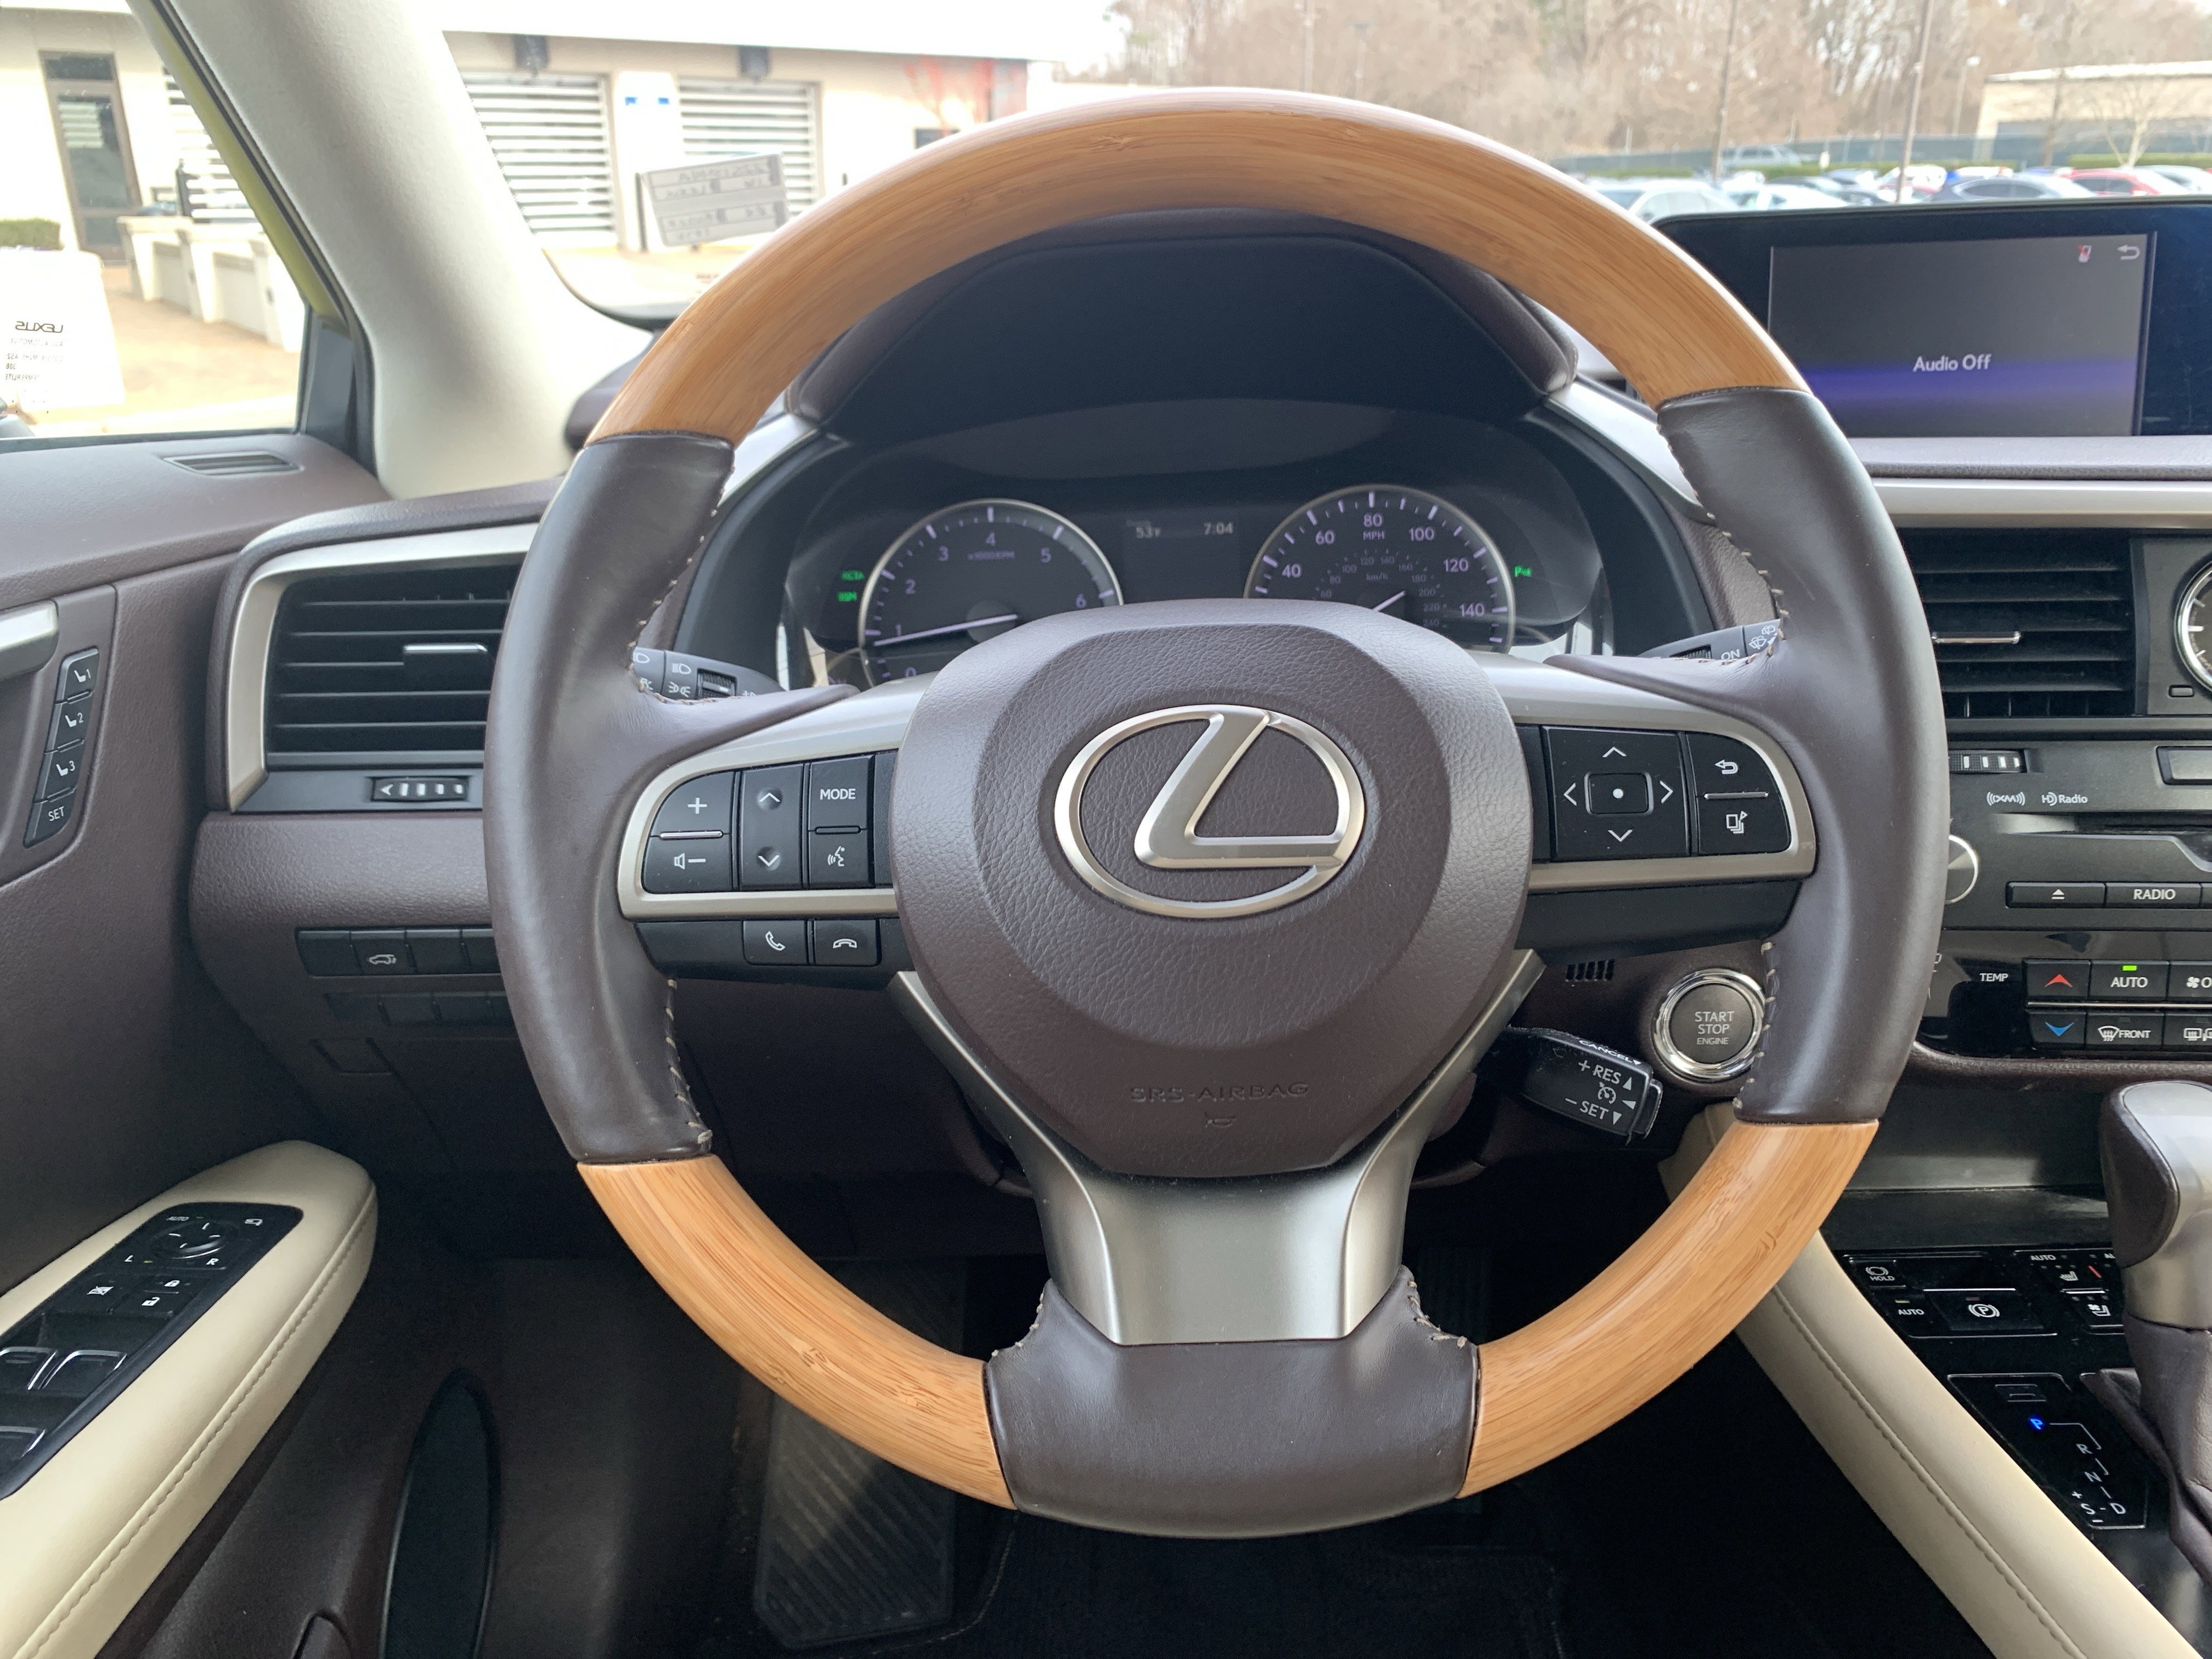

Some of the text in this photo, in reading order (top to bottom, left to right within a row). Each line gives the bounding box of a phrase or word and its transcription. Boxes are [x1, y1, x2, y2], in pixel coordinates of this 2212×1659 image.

[1913, 353, 1992, 372] Audio Off
[1363, 514, 1384, 527] 80
[1203, 522, 1234, 535] 7:04
[1363, 530, 1385, 540] MPH
[1409, 526, 1435, 541] 100
[986, 531, 996, 546] 4
[1315, 529, 1335, 545] 60
[938, 546, 949, 561] 3
[1041, 547, 1052, 563] 5
[1282, 563, 1302, 578] 40
[1443, 557, 1469, 572] 120
[906, 579, 916, 594] 2
[1076, 593, 1087, 608] 6
[1459, 603, 1486, 618] 140
[1721, 648, 1740, 661] ON
[86, 669, 92, 679] 1
[77, 712, 84, 724] 2
[69, 760, 76, 772] 3
[820, 788, 856, 800] MODE
[2058, 794, 2088, 804] Radio
[48, 806, 65, 822] SET
[2134, 889, 2176, 900] RADIO
[1979, 973, 2009, 983] TEMP
[2111, 977, 2149, 988] AUTO
[1695, 1011, 1735, 1022] START
[1697, 1024, 1730, 1035] STOP
[2118, 1030, 2152, 1039] FRONT
[1696, 1037, 1729, 1045] ENGINE
[1579, 1040, 1632, 1063] CANCEL
[1130, 1082, 1310, 1103] SRS-AIRBAG
[2029, 1418, 2044, 1430] P
[2076, 1443, 2093, 1454] R
[2084, 1471, 2103, 1482] N
[2080, 1503, 2096, 1515] S
[2109, 1502, 2126, 1515] D
